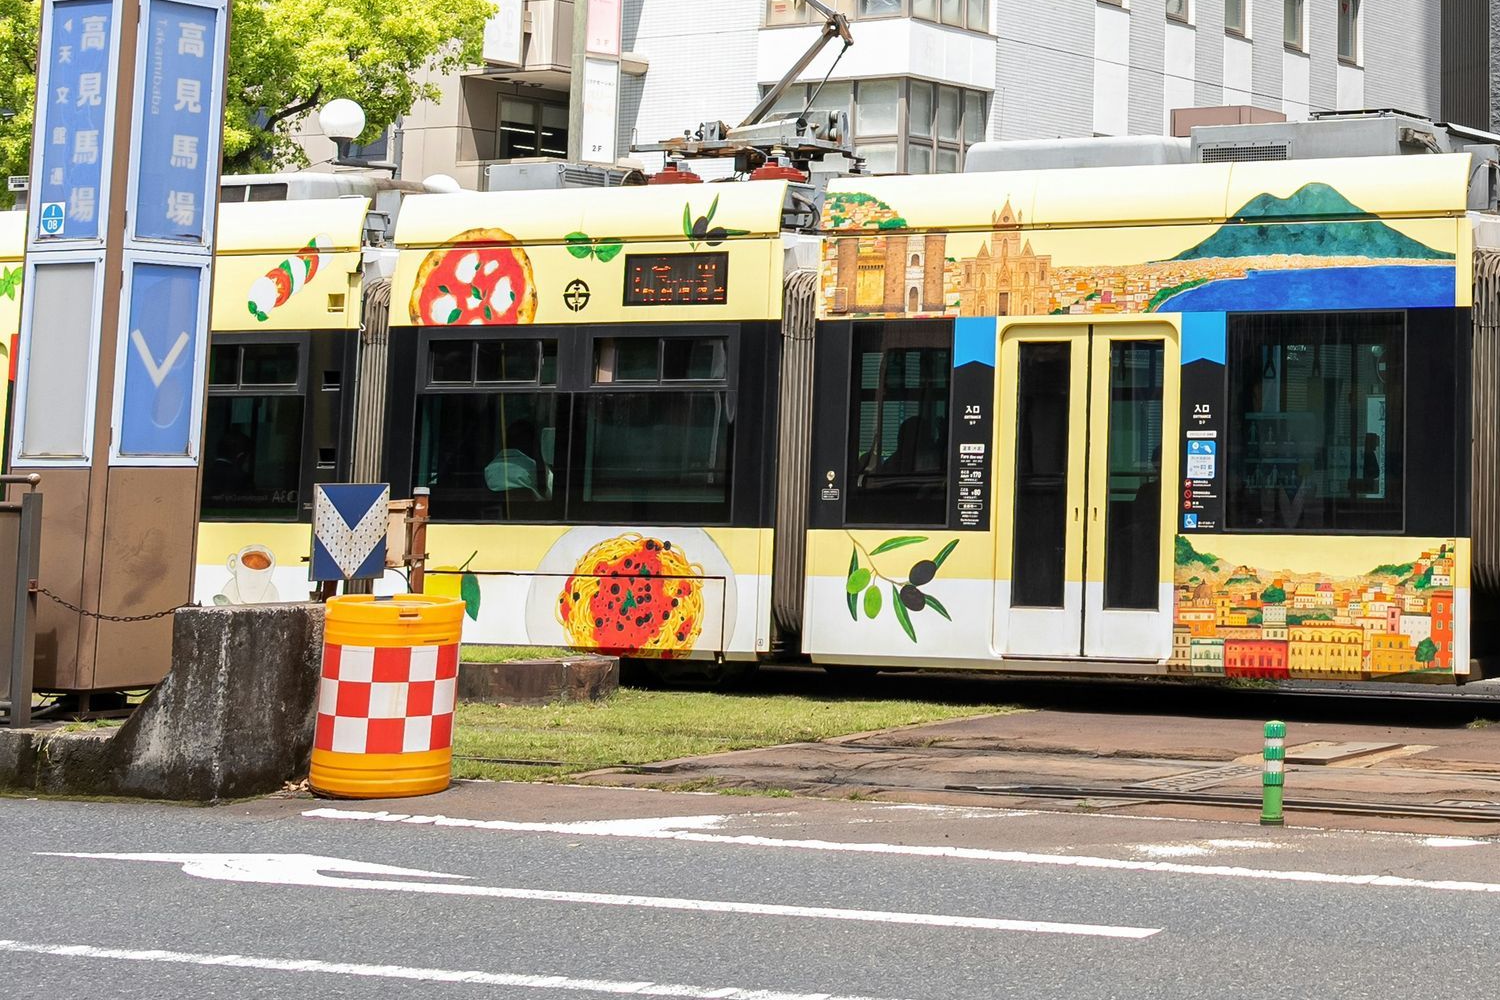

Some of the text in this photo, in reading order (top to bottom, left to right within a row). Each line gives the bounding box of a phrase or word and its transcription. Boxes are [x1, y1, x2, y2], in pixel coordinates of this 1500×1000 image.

[69, 15, 107, 223] 高見馬場
[166, 22, 207, 227] 高見馬場
[592, 144, 602, 152] 2F
[47, 219, 58, 230] 08
[965, 405, 980, 414] 入口
[1194, 404, 1210, 413] 入口
